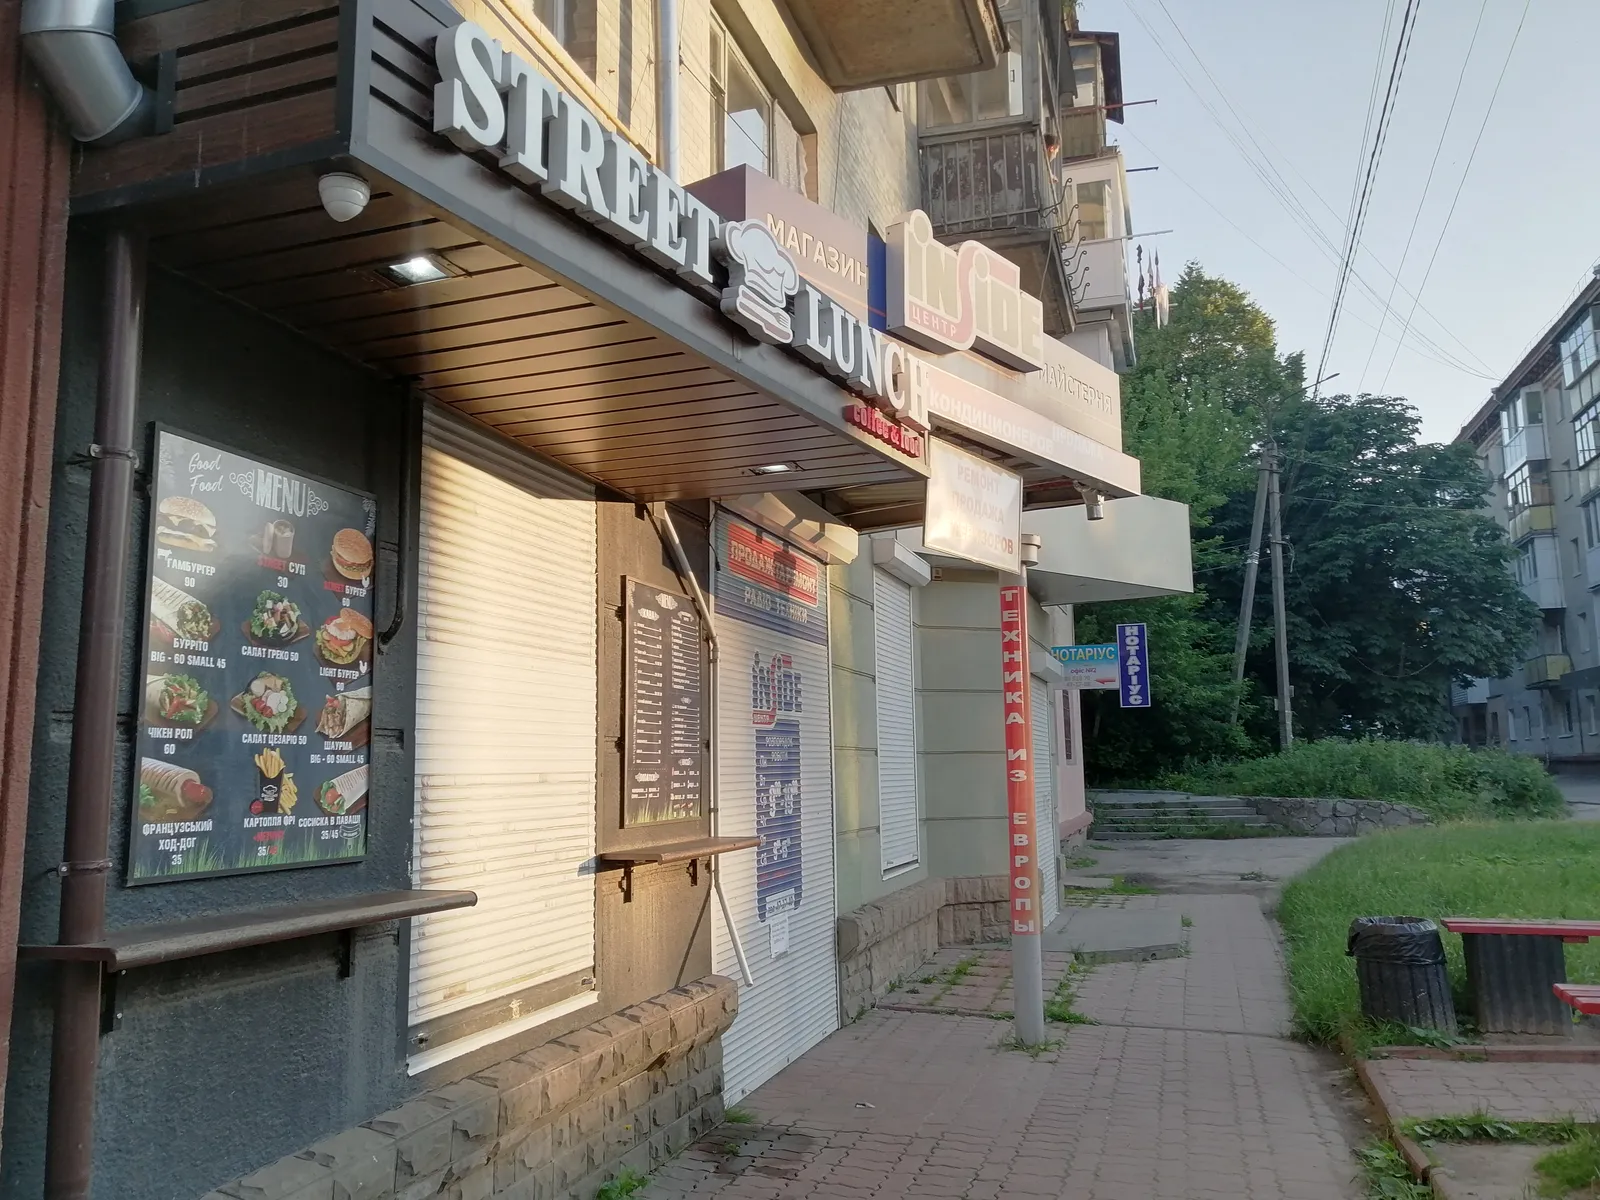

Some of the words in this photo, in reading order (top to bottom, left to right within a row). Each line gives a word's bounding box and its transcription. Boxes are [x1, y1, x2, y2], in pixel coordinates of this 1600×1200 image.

[438, 20, 719, 283] STREET
[766, 213, 867, 285] МАГАЗИН
[912, 304, 957, 337] ЦЕНТР
[803, 284, 931, 430] LUNCH
[1038, 363, 1112, 414] МАЙСТЕРНЯ
[929, 388, 1053, 455] КОНДИЦИОНЕРОВ
[188, 452, 221, 472] Good
[190, 474, 223, 495] Food
[957, 463, 999, 495] РЕМОНТ
[256, 469, 307, 517] MENU
[952, 490, 1004, 524] ПРОДАЖА
[731, 541, 774, 576] ПРОДАЖ
[167, 558, 216, 577] ГАМБУРГЕР
[289, 562, 306, 575] СУП
[184, 577, 196, 588] 90
[277, 576, 288, 588] 30
[345, 585, 367, 597] БУРГЕР
[173, 638, 209, 652] БУРРІТО
[151, 651, 167, 663] BIG
[174, 653, 185, 665] 60
[187, 655, 215, 667] SMALL
[216, 658, 226, 669] 45
[241, 646, 267, 658] САЛАТ
[268, 648, 289, 661] ГРЕКО
[290, 652, 299, 662] 50
[1001, 589, 1026, 725] ТЕХНИКА
[1051, 647, 1115, 661] НОТАРІУС
[320, 666, 337, 678] LIGHT
[337, 668, 359, 680] БУРГЕР
[1124, 626, 1143, 705] НОТАРІУС
[148, 727, 173, 739] ЧІКЕН
[174, 728, 193, 739] РОЛ
[242, 734, 267, 745] САЛАТ
[268, 734, 298, 746] ЦЕЗАРІО
[298, 735, 307, 745] 50
[164, 743, 176, 755] 60
[324, 741, 352, 751] ШАУРМА
[310, 754, 321, 764] BIG
[326, 755, 335, 764] 60
[336, 755, 356, 764] SMALL
[1008, 748, 1028, 782] ИЗ
[142, 819, 213, 836] ФРАНЦУЗСЬКИЙ
[243, 816, 282, 828] КАРТОПЛЯ
[283, 815, 296, 826] ФРІ
[298, 816, 329, 828] СОСИСКА
[330, 816, 335, 826] В
[335, 814, 361, 825] ЛАВАШІ
[158, 837, 197, 852] ХОД-ДОГ
[172, 854, 183, 866] 35
[1013, 812, 1034, 933] ЕВРОПЫ
